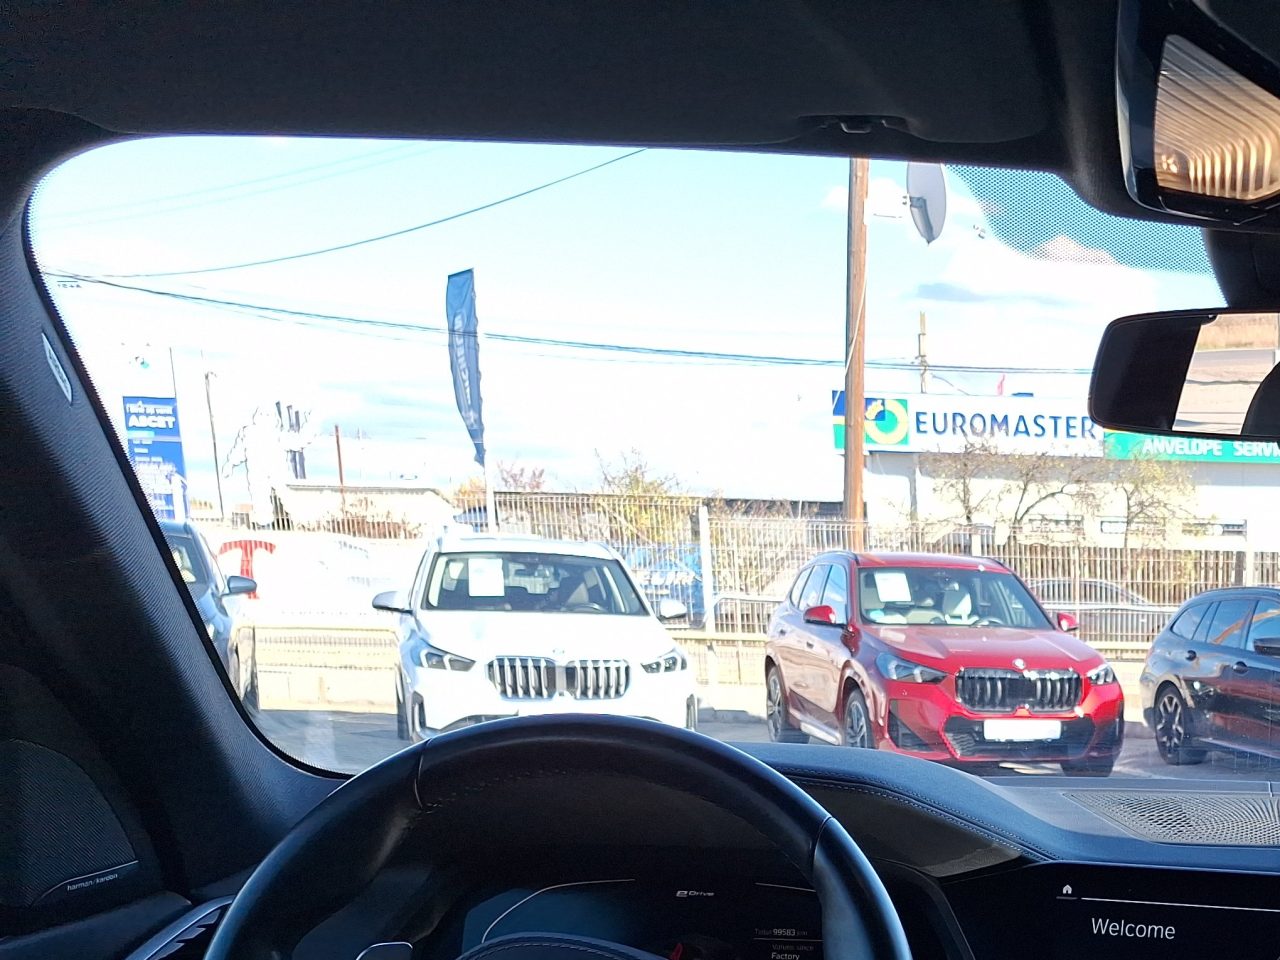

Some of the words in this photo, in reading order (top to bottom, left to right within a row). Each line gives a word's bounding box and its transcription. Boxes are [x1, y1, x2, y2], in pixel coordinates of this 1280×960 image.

[915, 411, 1097, 440] EUROMASTER
[1142, 436, 1223, 456] ANVELOPE
[67, 872, 118, 892] harman/kardon
[772, 928, 796, 937] 99583
[1091, 917, 1176, 940] Welcome
[771, 953, 800, 960] Factory
